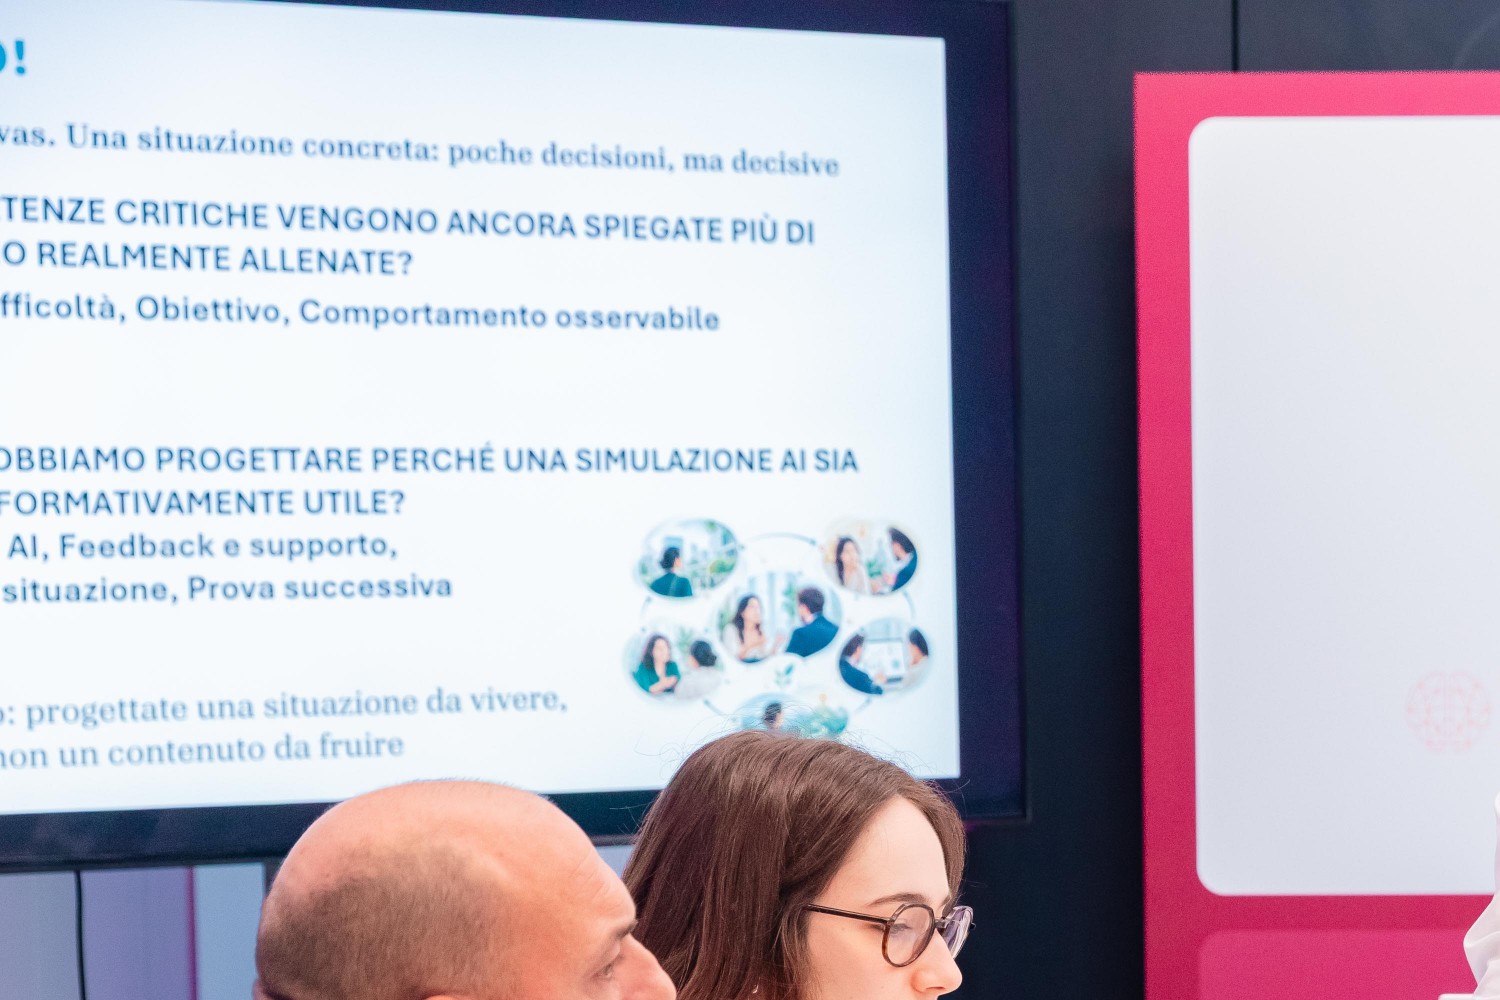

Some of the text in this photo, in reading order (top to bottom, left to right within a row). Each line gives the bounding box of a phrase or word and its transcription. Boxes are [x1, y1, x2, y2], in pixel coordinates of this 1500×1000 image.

[66, 122, 128, 150] Una
[137, 125, 294, 156] situazione
[301, 138, 439, 162] concreta:
[447, 138, 533, 169] poche
[540, 140, 675, 173] decisioni,
[682, 153, 725, 173] ma
[730, 147, 840, 177] decisive
[0, 194, 815, 246] TENZE CRITICHE VENGONO ANCORA SPIEGATE PIÙ DI
[36, 241, 231, 272] REALMENTE
[239, 246, 414, 276] ALLENATE?
[135, 294, 290, 327] Obiettivo,
[298, 298, 548, 331] Comportamento
[554, 305, 720, 332] osservabile
[155, 446, 362, 473] PROGETTARE
[371, 441, 495, 473] PERCHÉ
[503, 447, 569, 473] UNA
[575, 447, 773, 473] SIMULAZIONE
[779, 447, 807, 473] AI
[813, 448, 860, 473] SIA
[303, 489, 406, 516] UTILE?
[7, 532, 398, 563] AI, Feedback e supporto,
[1, 572, 453, 604] situazione, Prova successiva
[25, 697, 189, 732] progettate
[196, 699, 256, 721] una
[263, 689, 419, 719] situazione
[425, 686, 463, 715] da
[469, 686, 569, 713] vivere,
[58, 746, 100, 768] un
[107, 738, 267, 767] contenuto
[273, 732, 312, 761] da
[319, 730, 405, 760] fruire
